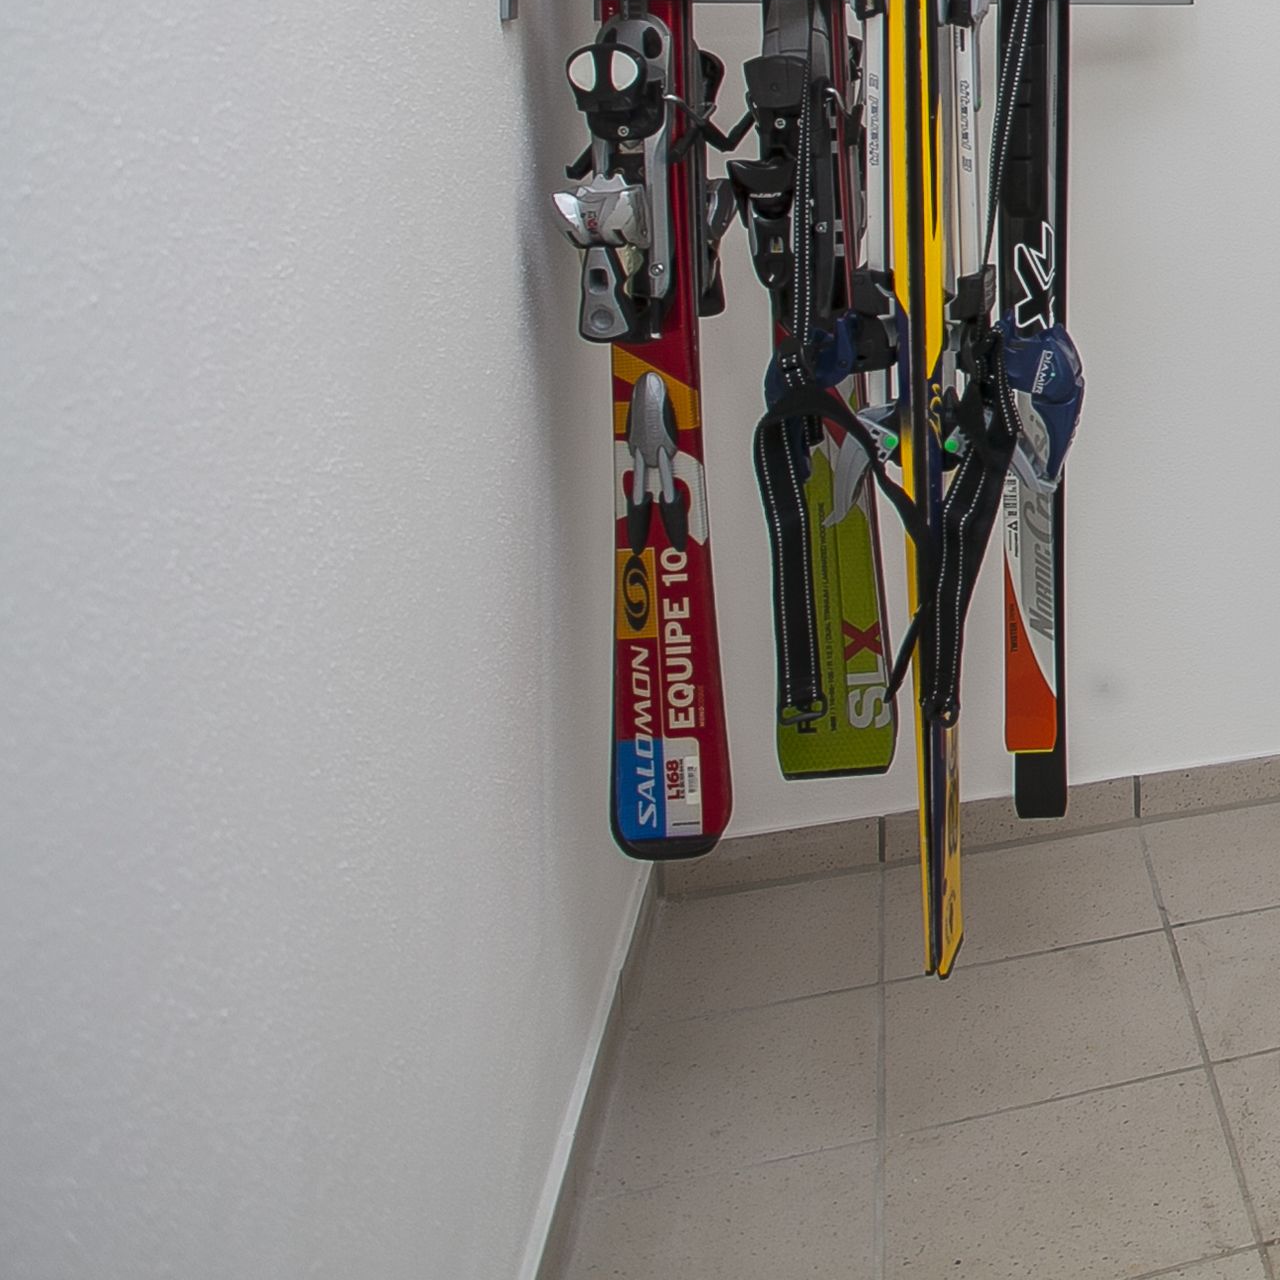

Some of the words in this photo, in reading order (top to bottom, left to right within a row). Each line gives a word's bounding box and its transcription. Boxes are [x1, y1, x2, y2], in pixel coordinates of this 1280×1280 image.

[1032, 349, 1054, 395] DIAMIR
[660, 547, 689, 586] 10
[1028, 543, 1055, 641] NORDIC
[663, 597, 696, 730] EQUIPE
[842, 619, 891, 729] SLX
[630, 645, 657, 828] SALOMON
